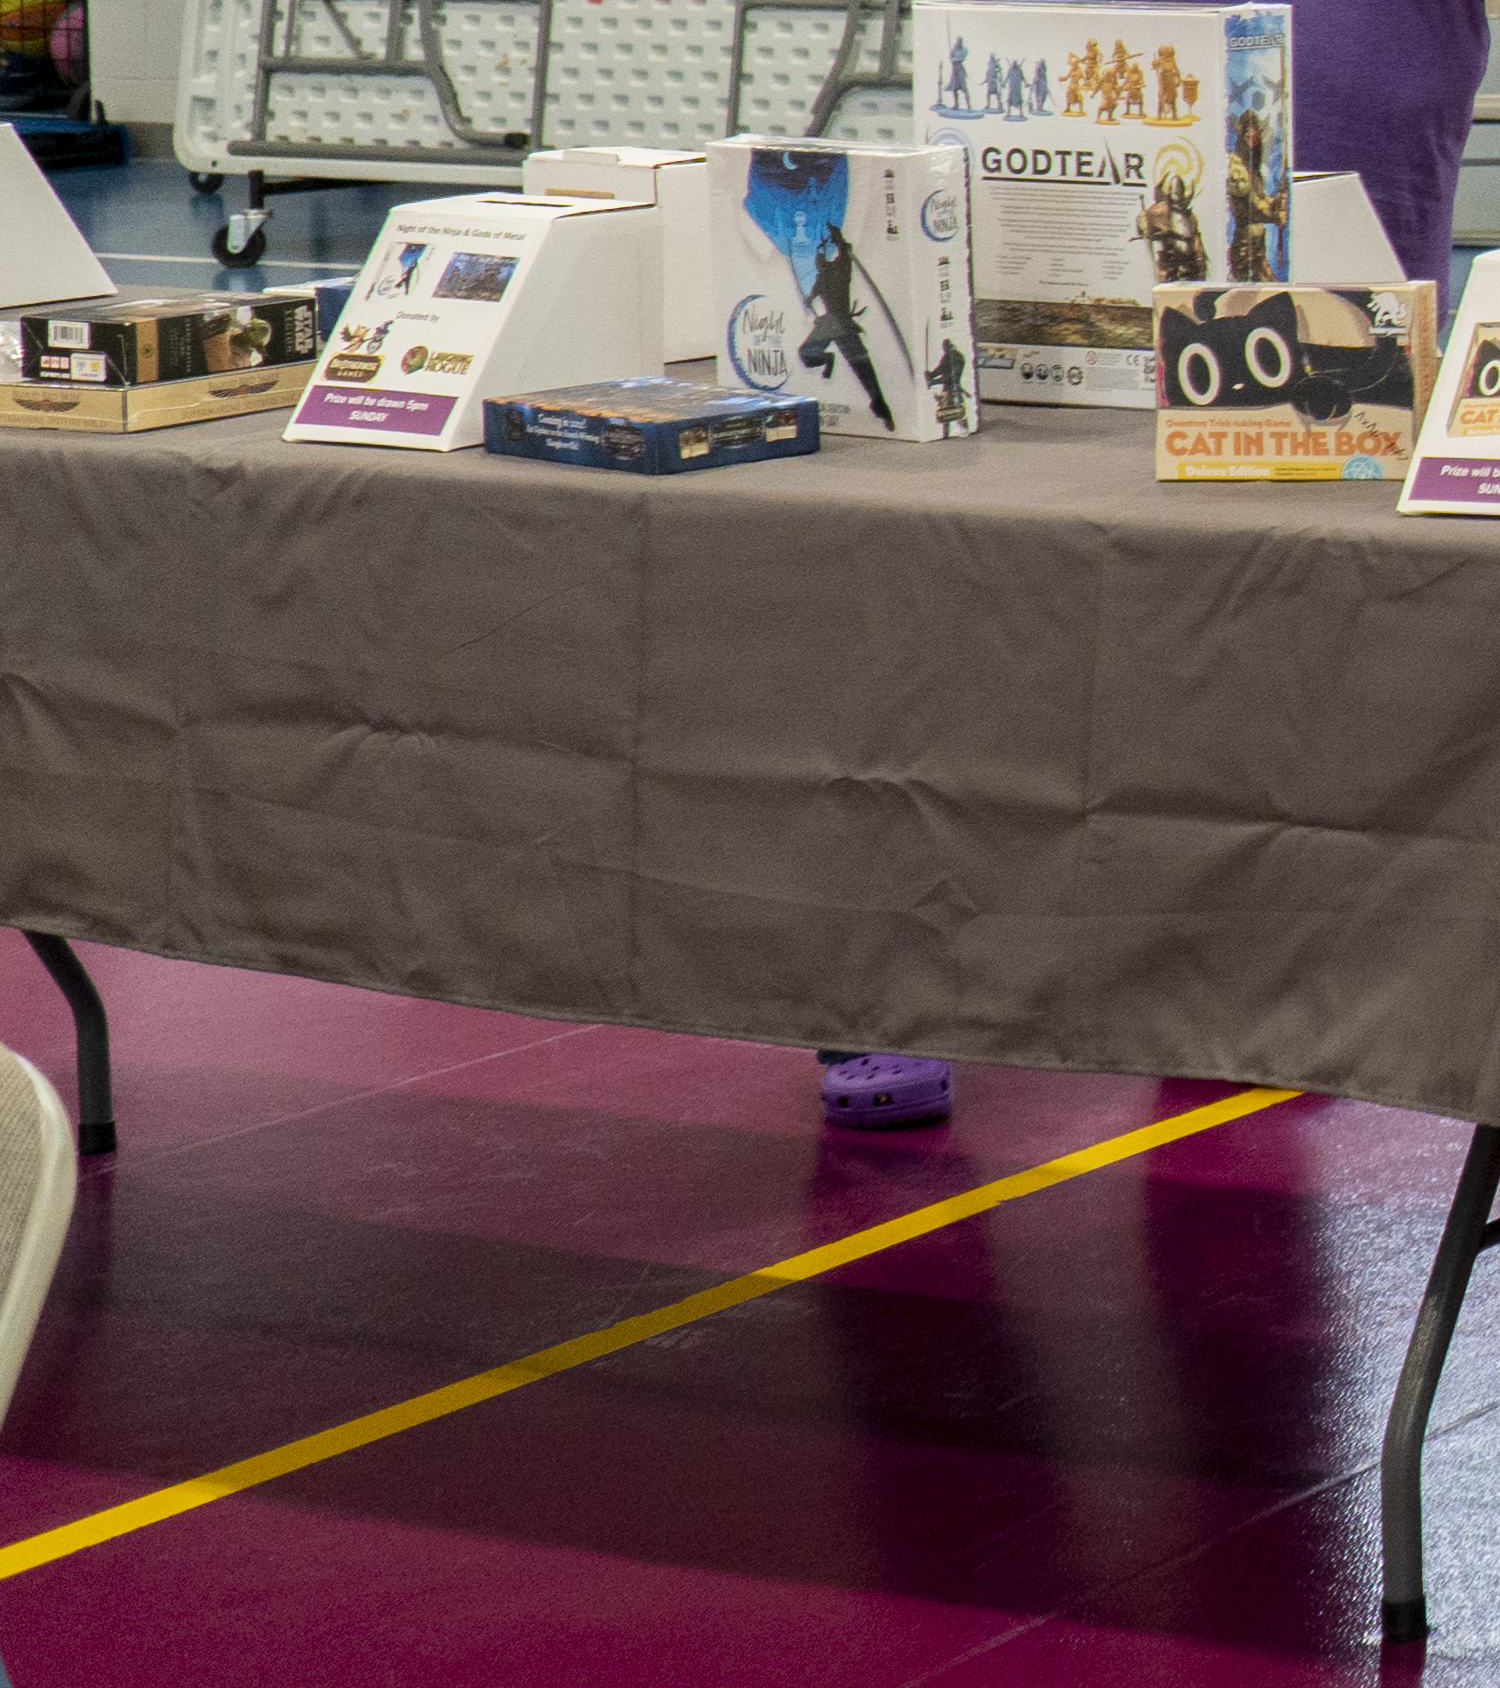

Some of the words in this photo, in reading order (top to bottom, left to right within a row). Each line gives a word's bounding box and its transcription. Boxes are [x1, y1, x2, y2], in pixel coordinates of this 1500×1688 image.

[981, 139, 1147, 185] GODTEAR
[747, 349, 789, 376] NINJA
[323, 393, 347, 404] Prize
[348, 396, 364, 405] will
[364, 396, 376, 406] be
[349, 411, 389, 422] SUNDAY
[1460, 408, 1498, 425] CAT
[1164, 432, 1228, 457] CAT
[1233, 432, 1265, 457] IN
[1269, 432, 1330, 457] THE
[1334, 432, 1403, 457] BOX
[1185, 464, 1226, 477] Deluxe
[1228, 465, 1271, 477] Edition
[1440, 465, 1469, 477] Prize
[1471, 467, 1490, 478] will
